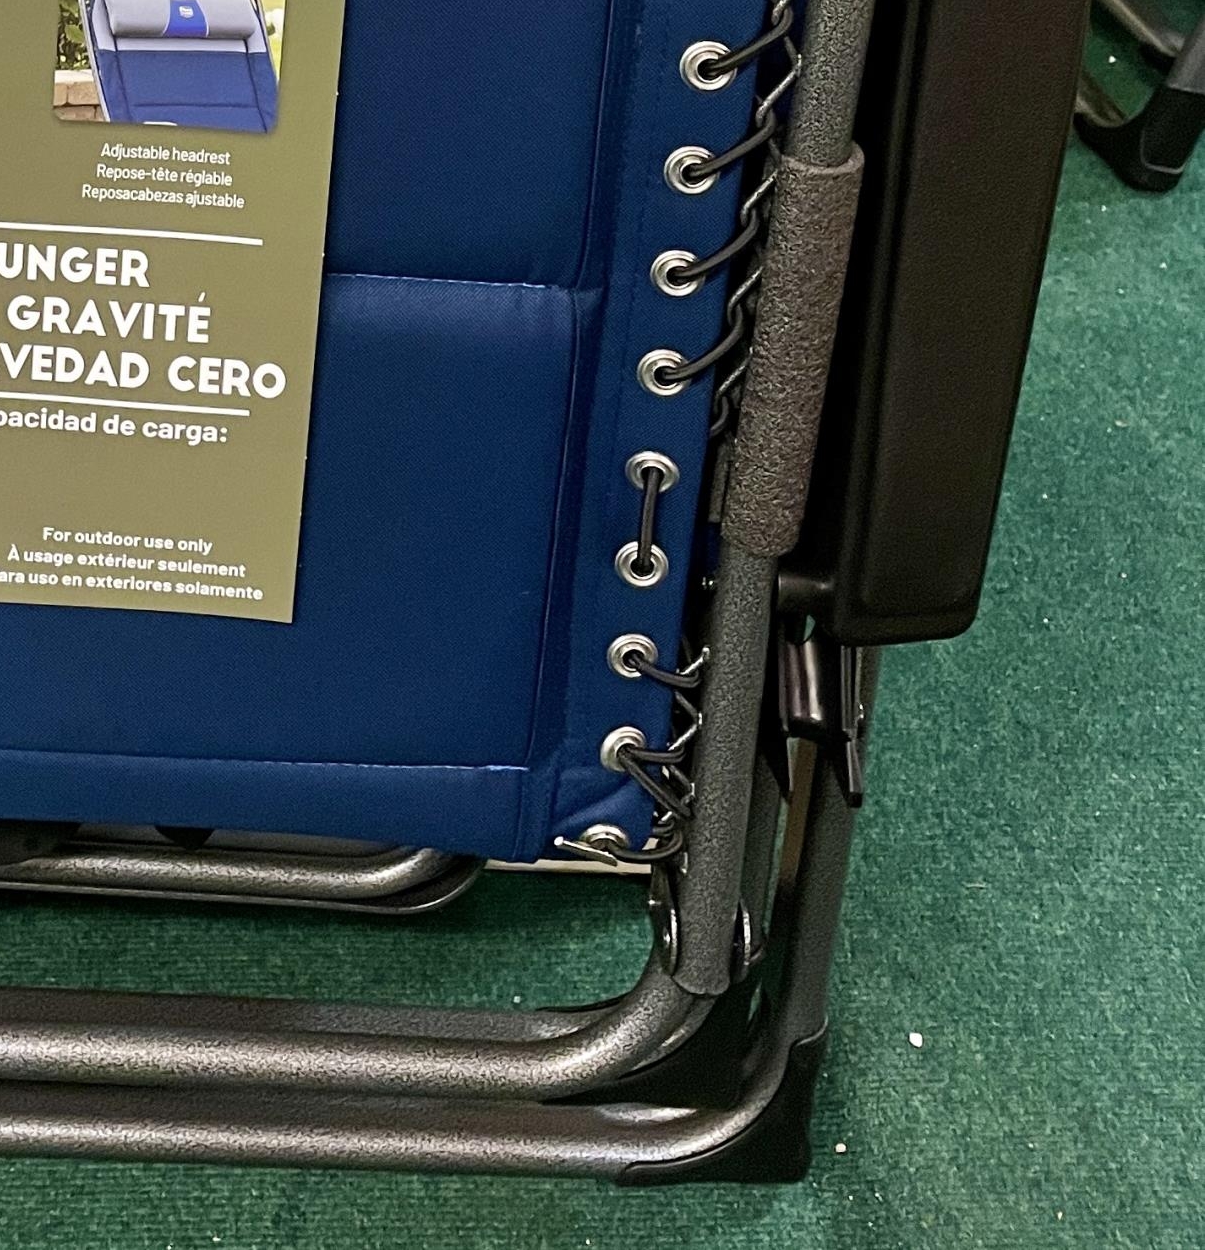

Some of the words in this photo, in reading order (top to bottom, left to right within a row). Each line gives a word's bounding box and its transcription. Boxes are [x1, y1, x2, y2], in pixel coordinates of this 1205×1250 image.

[100, 142, 170, 161] Adjustable
[172, 147, 231, 166] headrest
[96, 163, 179, 182] Repose-tête
[180, 168, 233, 187] réglable
[81, 183, 184, 204] Reposacabezas
[185, 190, 245, 209] ajustable
[6, 291, 212, 344] GRAVITÉ
[167, 355, 287, 400] CERO
[102, 412, 137, 438] de
[141, 421, 230, 447] carga:
[42, 526, 72, 543] For
[74, 530, 142, 547] outdoor
[144, 536, 175, 550] use
[177, 538, 213, 556] only
[7, 543, 20, 562] À
[23, 550, 74, 568] usage
[77, 552, 156, 570] extérieur
[157, 559, 247, 578] seulement
[28, 572, 59, 586] uso
[61, 574, 83, 588] en
[85, 575, 173, 593] exteriores
[174, 581, 264, 601] solamente
